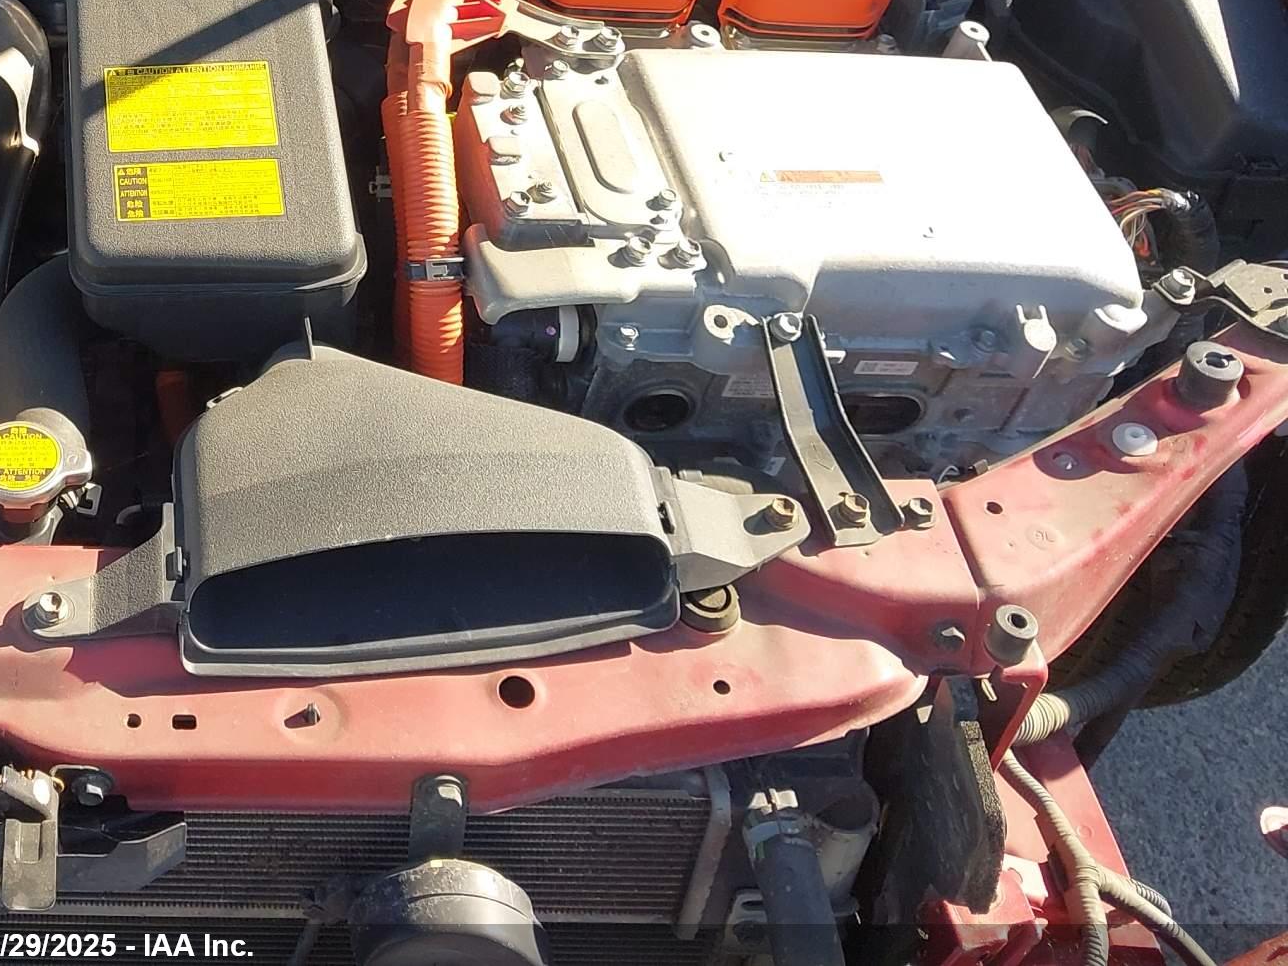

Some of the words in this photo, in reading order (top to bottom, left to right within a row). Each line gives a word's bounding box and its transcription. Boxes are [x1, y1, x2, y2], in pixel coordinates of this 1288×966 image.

[137, 67, 173, 76] CAUTION
[176, 65, 222, 74] ATTENTION
[119, 177, 148, 186] CAUTION
[120, 189, 148, 198] ATTENTION
